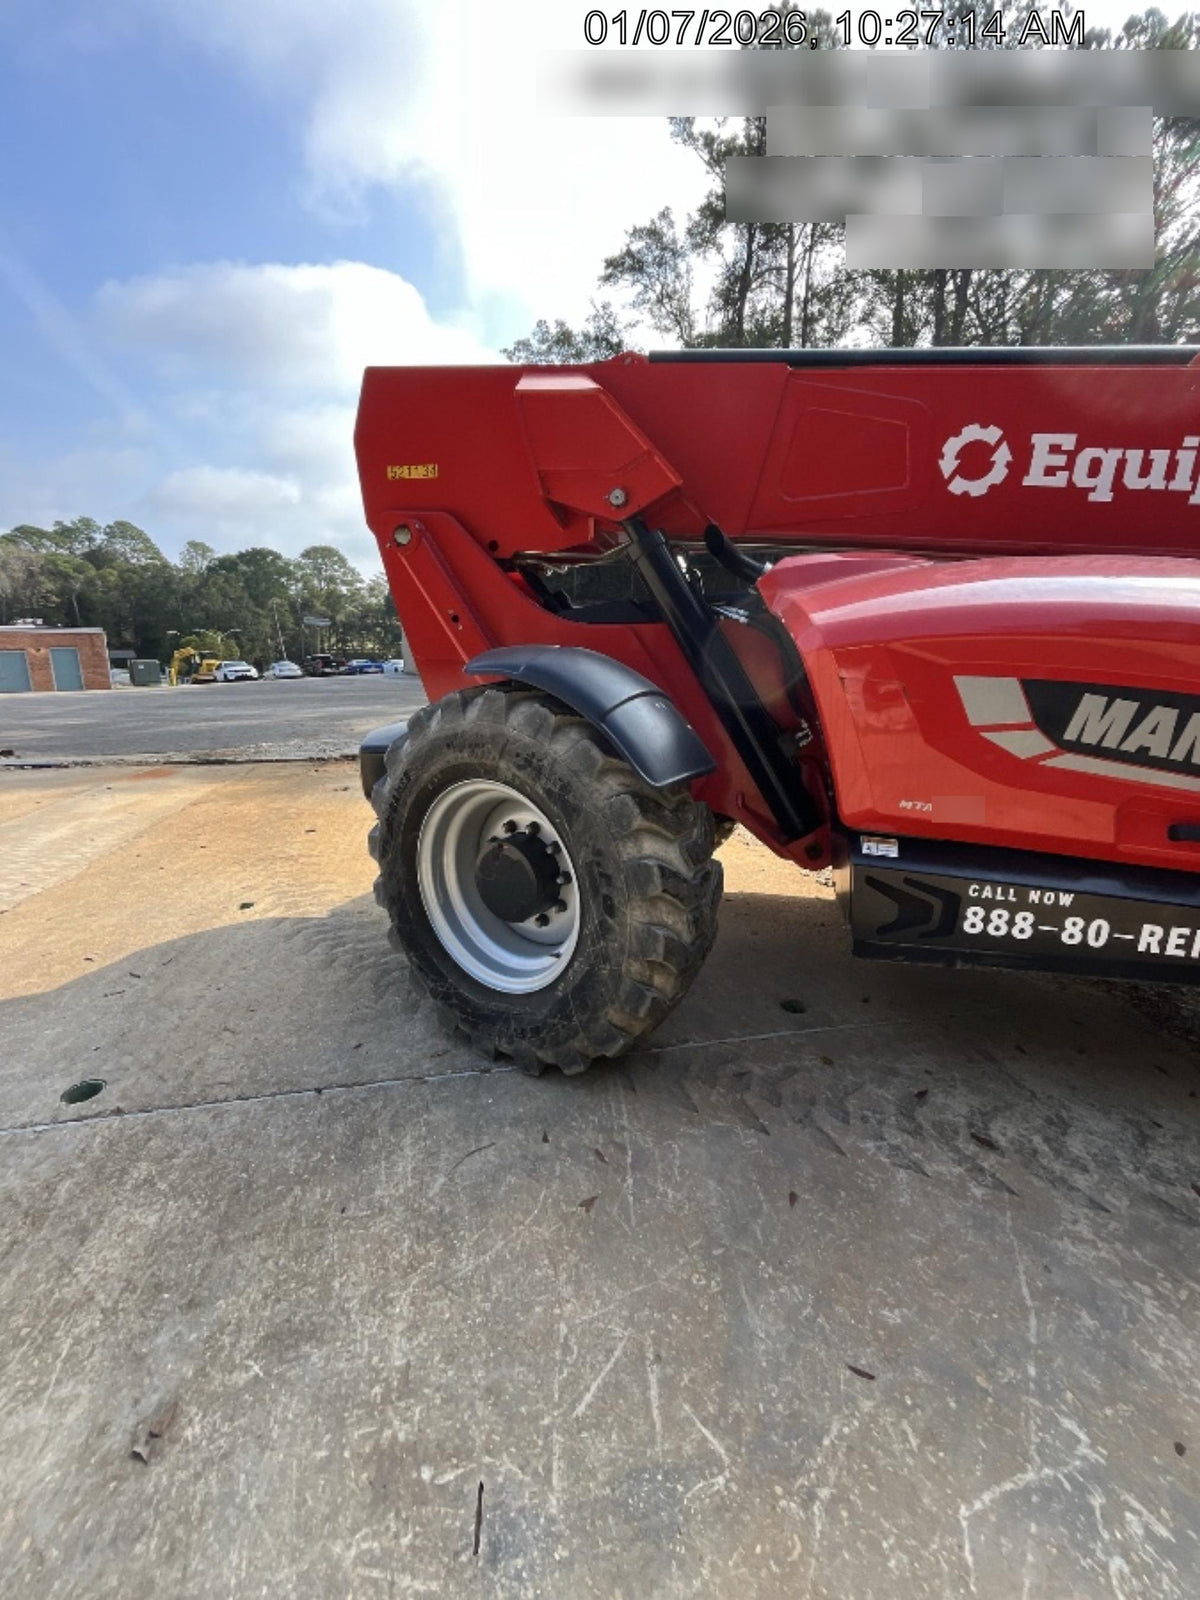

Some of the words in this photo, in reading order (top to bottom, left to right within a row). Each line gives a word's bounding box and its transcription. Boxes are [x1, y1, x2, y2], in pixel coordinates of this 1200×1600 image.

[1022, 433, 1200, 505] Equi
[968, 883, 1017, 902] CALL
[1028, 890, 1075, 907] NOW
